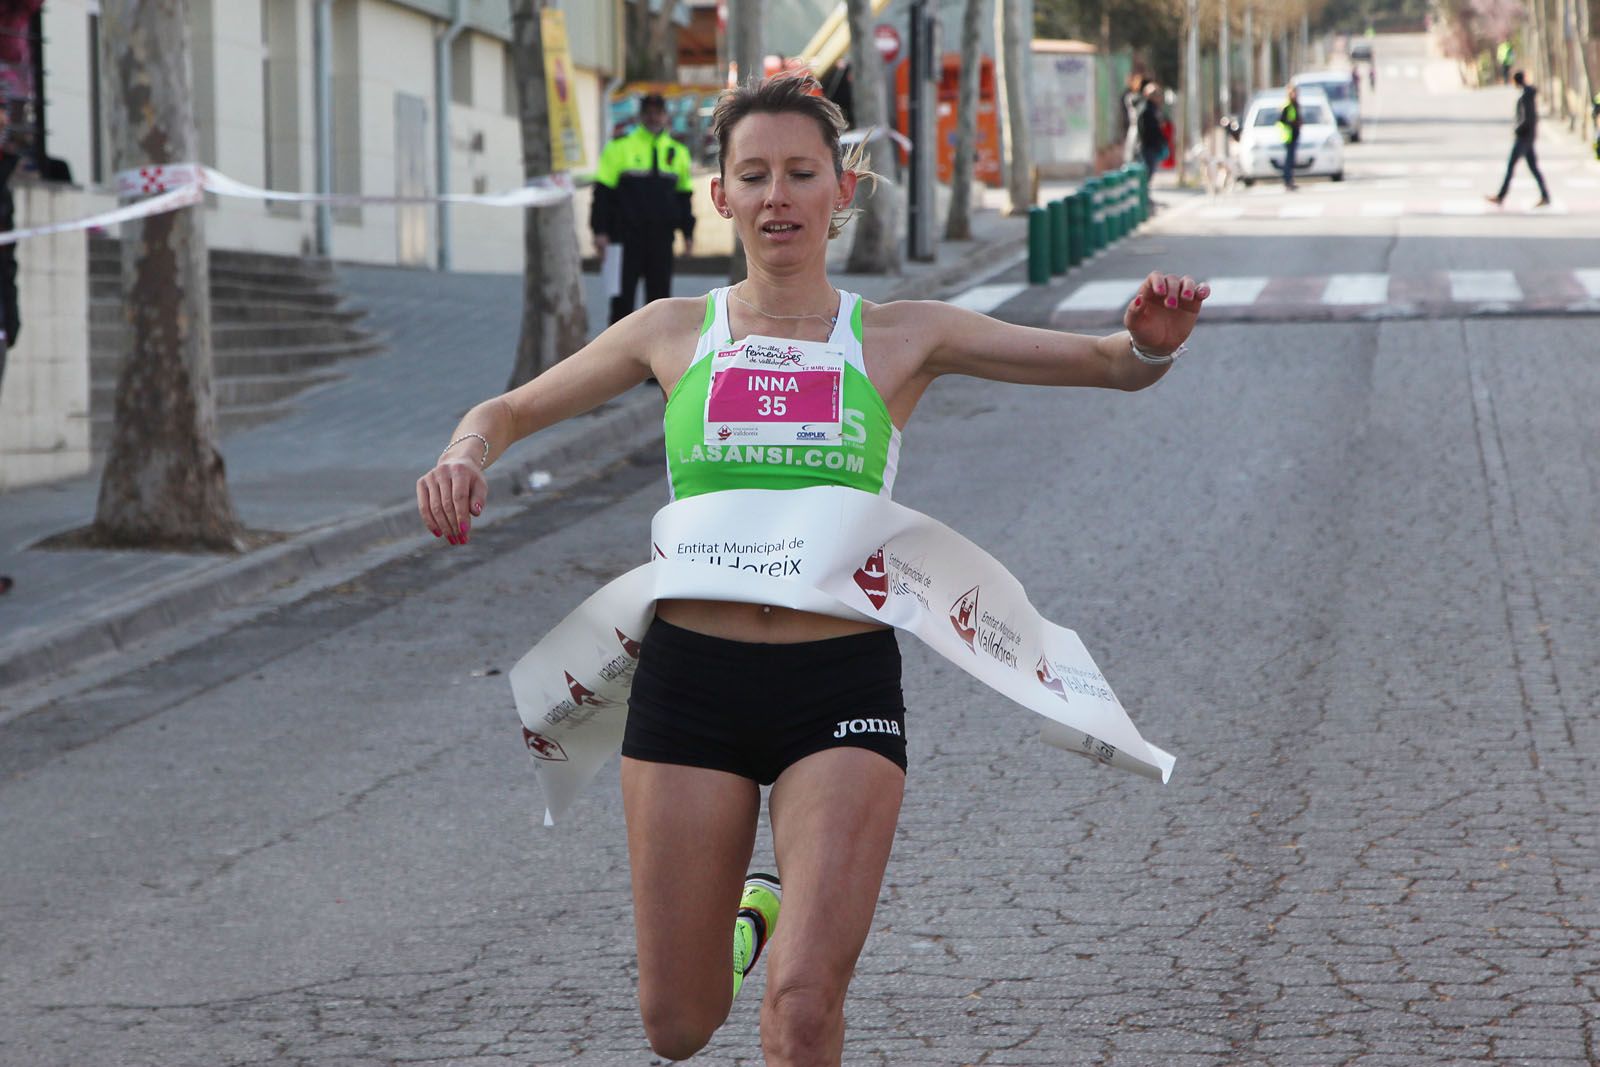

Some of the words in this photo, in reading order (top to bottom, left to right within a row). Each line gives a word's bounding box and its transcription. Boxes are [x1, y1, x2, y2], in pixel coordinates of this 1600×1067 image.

[746, 345, 801, 363] femenines
[748, 375, 800, 393] INNA
[757, 395, 787, 416] 35
[796, 431, 826, 439] COMPLEX
[677, 542, 719, 554] Entitat
[723, 540, 785, 556] Municipal
[788, 537, 804, 549] de
[977, 626, 1018, 669] Valldoreix
